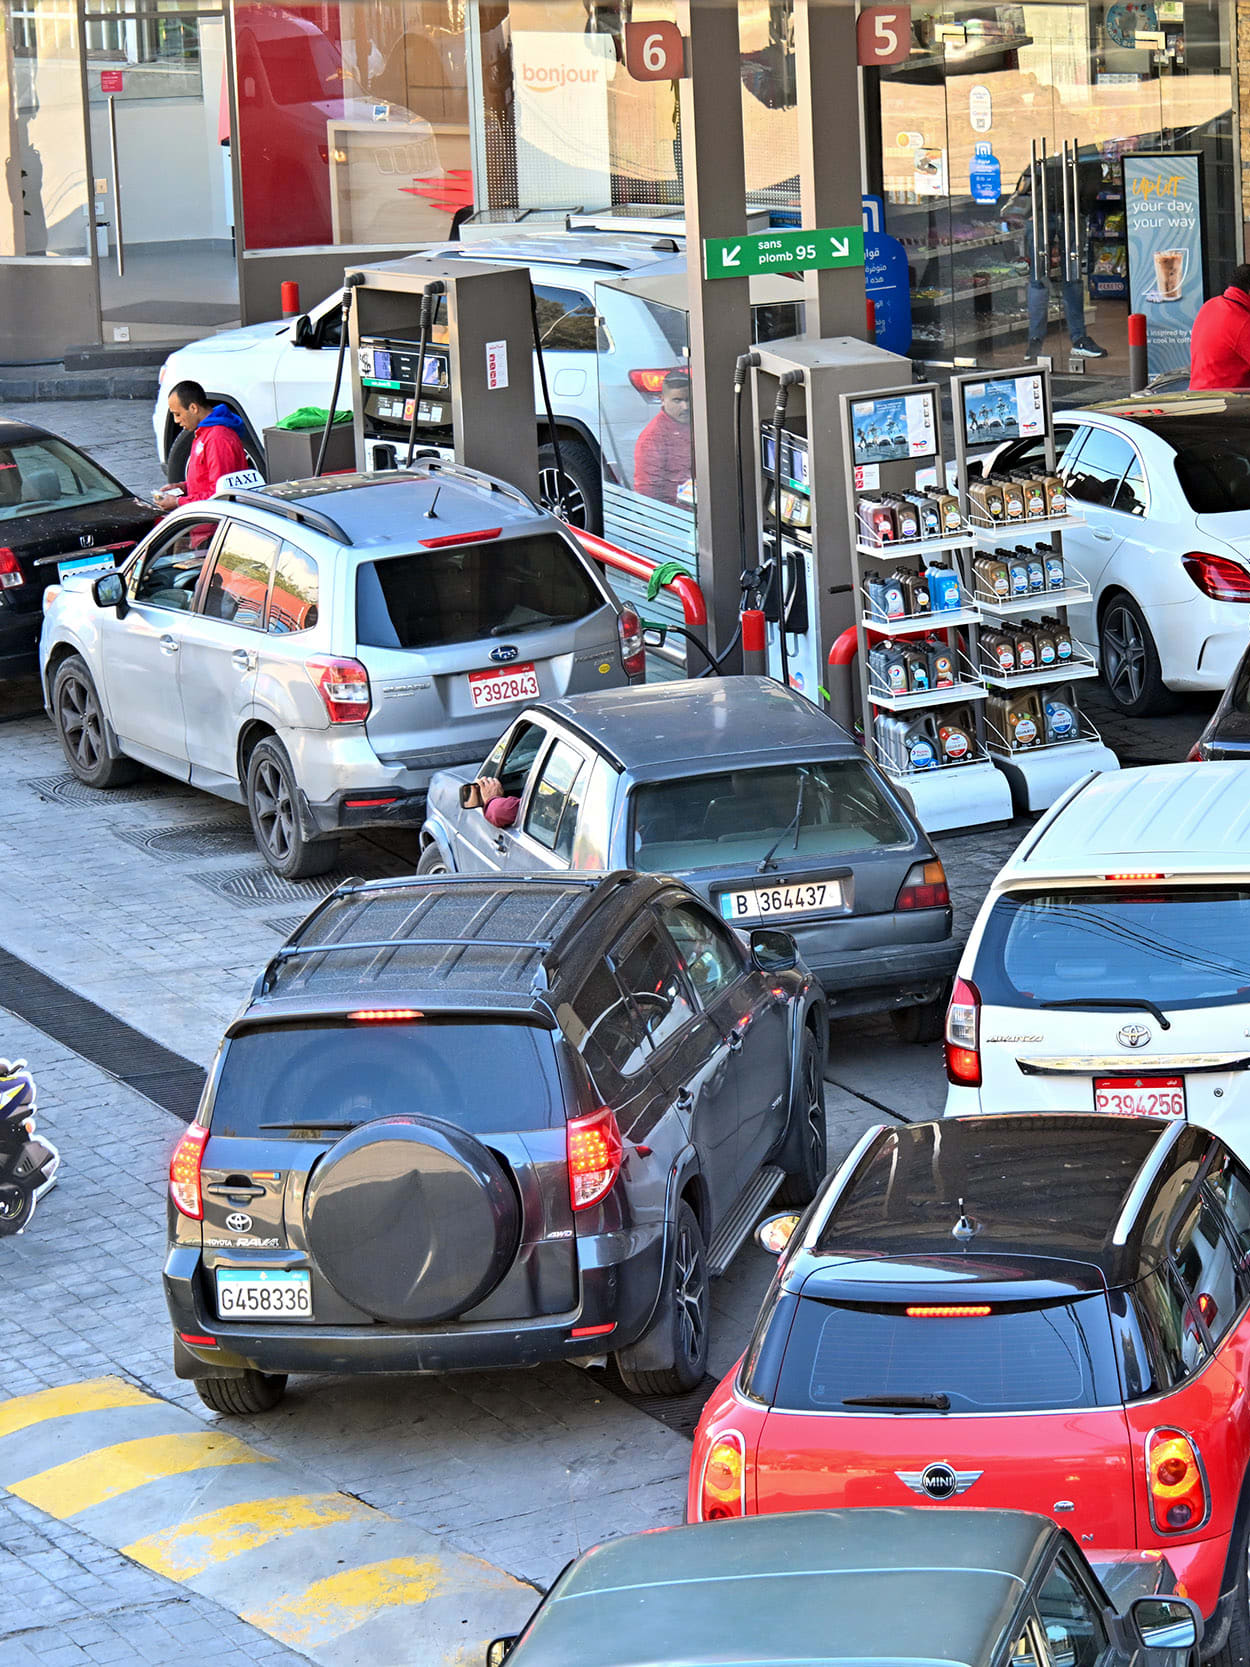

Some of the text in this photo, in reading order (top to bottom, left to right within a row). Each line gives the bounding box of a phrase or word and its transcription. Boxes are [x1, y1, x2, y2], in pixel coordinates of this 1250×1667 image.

[875, 15, 898, 56] 5
[643, 34, 667, 71] 6
[522, 64, 599, 86] bonjour
[1132, 200, 1194, 214] your day,
[1133, 217, 1197, 231] your way
[757, 240, 782, 250] sans
[758, 245, 817, 265] plomb 95
[226, 473, 258, 487] TAXI
[473, 677, 538, 705] P392843
[736, 885, 827, 915] B 364437
[1096, 1094, 1183, 1116] P394256
[206, 1238, 280, 1247] TOYOTA RAV4
[221, 1288, 309, 1310] G458336
[925, 1477, 953, 1488] MINI
